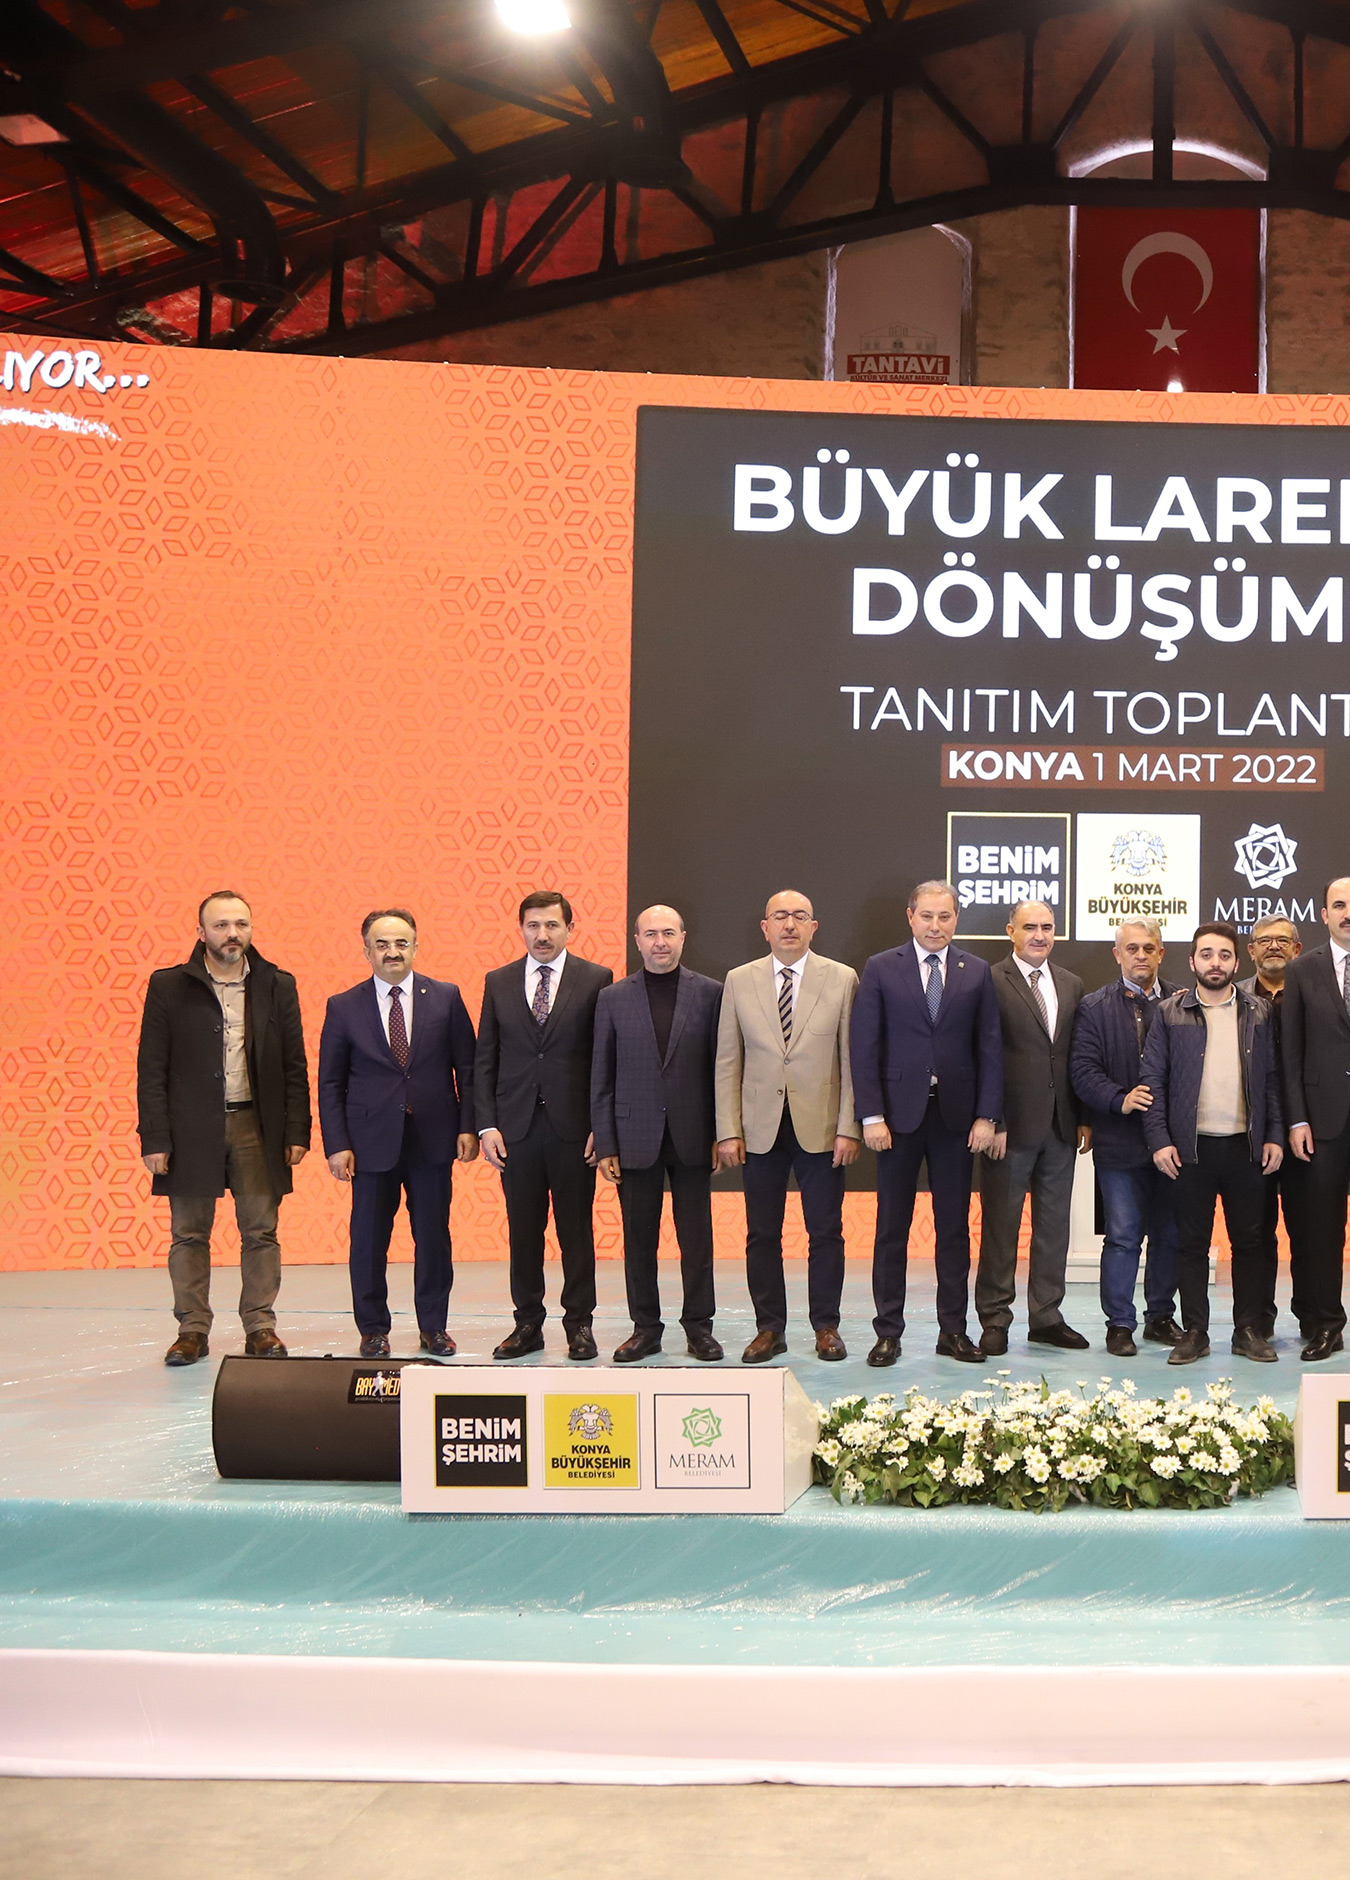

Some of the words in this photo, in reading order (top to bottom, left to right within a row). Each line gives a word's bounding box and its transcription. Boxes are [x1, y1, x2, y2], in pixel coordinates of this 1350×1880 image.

[0, 350, 150, 394] IYOR...
[850, 374, 878, 382] KÜLTÜR
[733, 448, 1065, 540] BÜYÜK
[839, 685, 1076, 735] TANITIM
[948, 750, 1085, 782] KONYA
[1092, 752, 1105, 781] 1
[1118, 752, 1224, 784] MART
[1232, 754, 1318, 785] 2022
[1113, 883, 1163, 896] KONYA
[1088, 896, 1188, 916] BÜYÜKŞEHİR
[1213, 897, 1318, 922] MERAM
[571, 1444, 611, 1455] KONYA
[551, 1455, 632, 1470] BÜYÜKŞEHİR
[669, 1453, 736, 1469] MERAM
[568, 1471, 616, 1479] BELEDİYESİ
